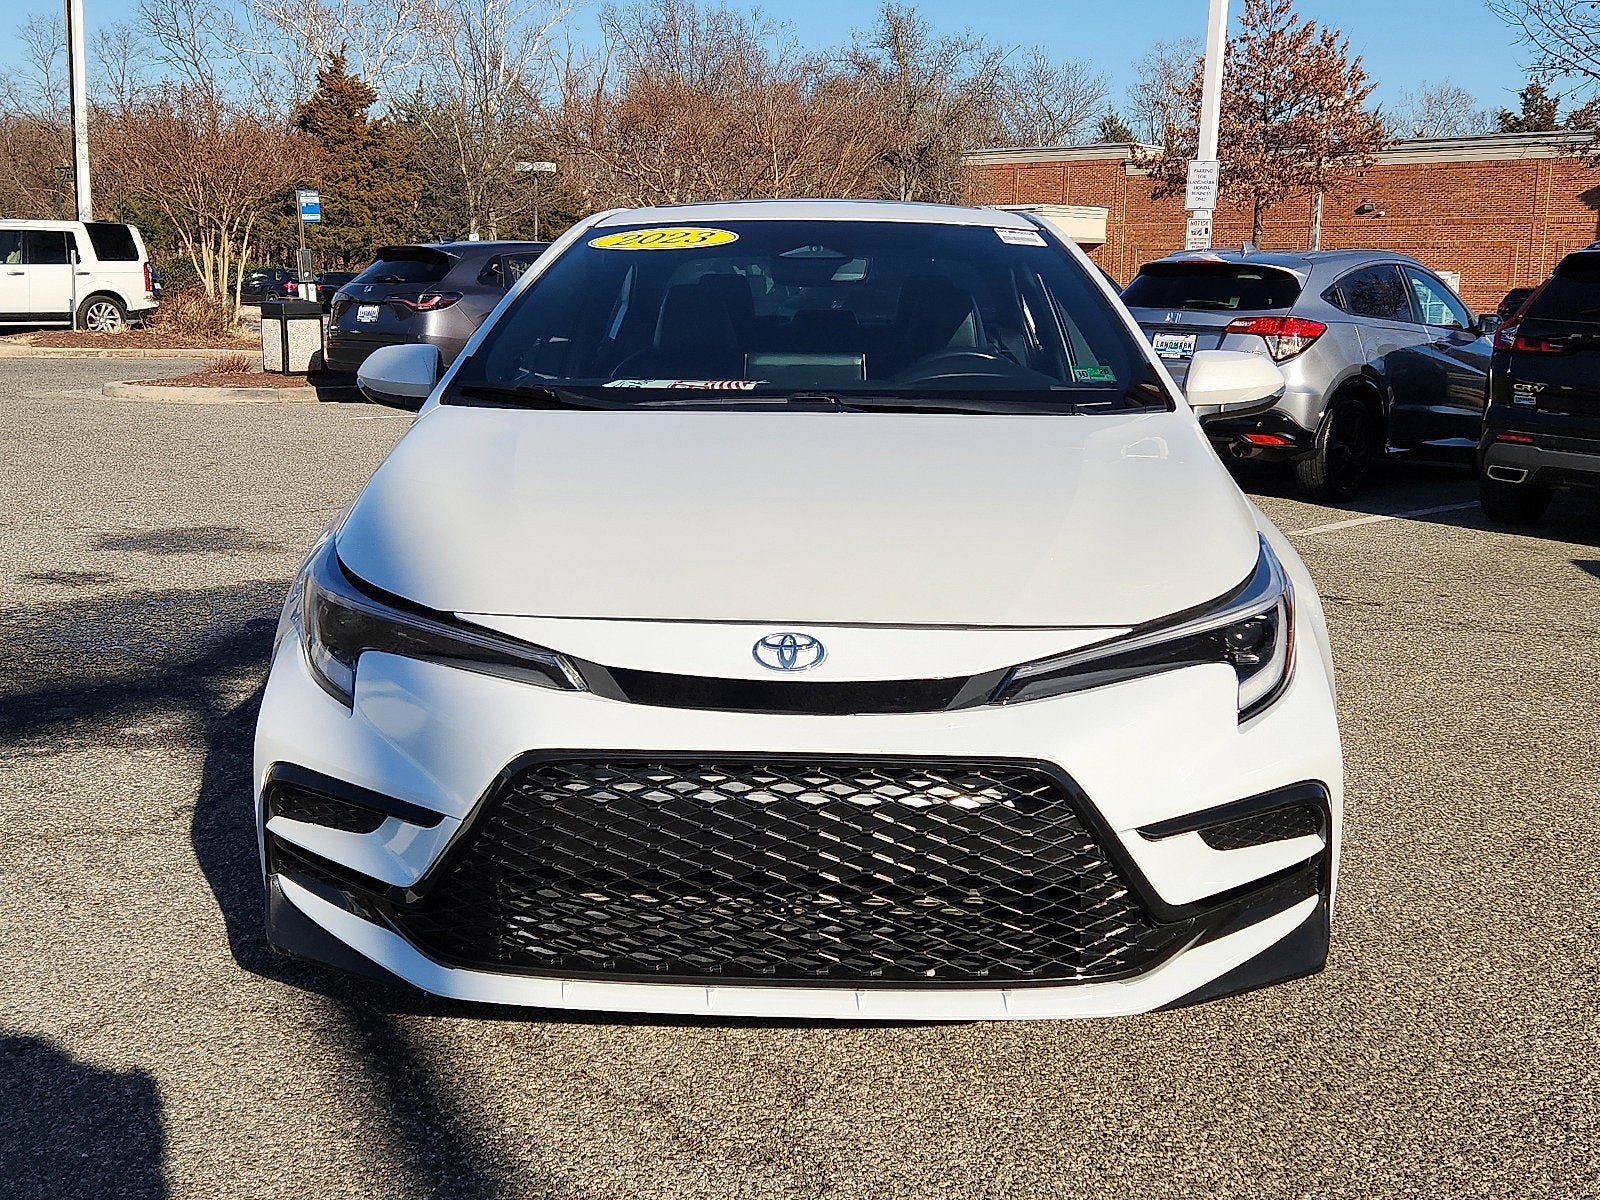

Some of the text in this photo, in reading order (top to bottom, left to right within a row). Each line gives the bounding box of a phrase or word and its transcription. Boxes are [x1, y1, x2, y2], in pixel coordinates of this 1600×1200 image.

[610, 232, 715, 246] 2023
[1155, 340, 1193, 350] LANDMARK
[1077, 369, 1089, 378] 10
